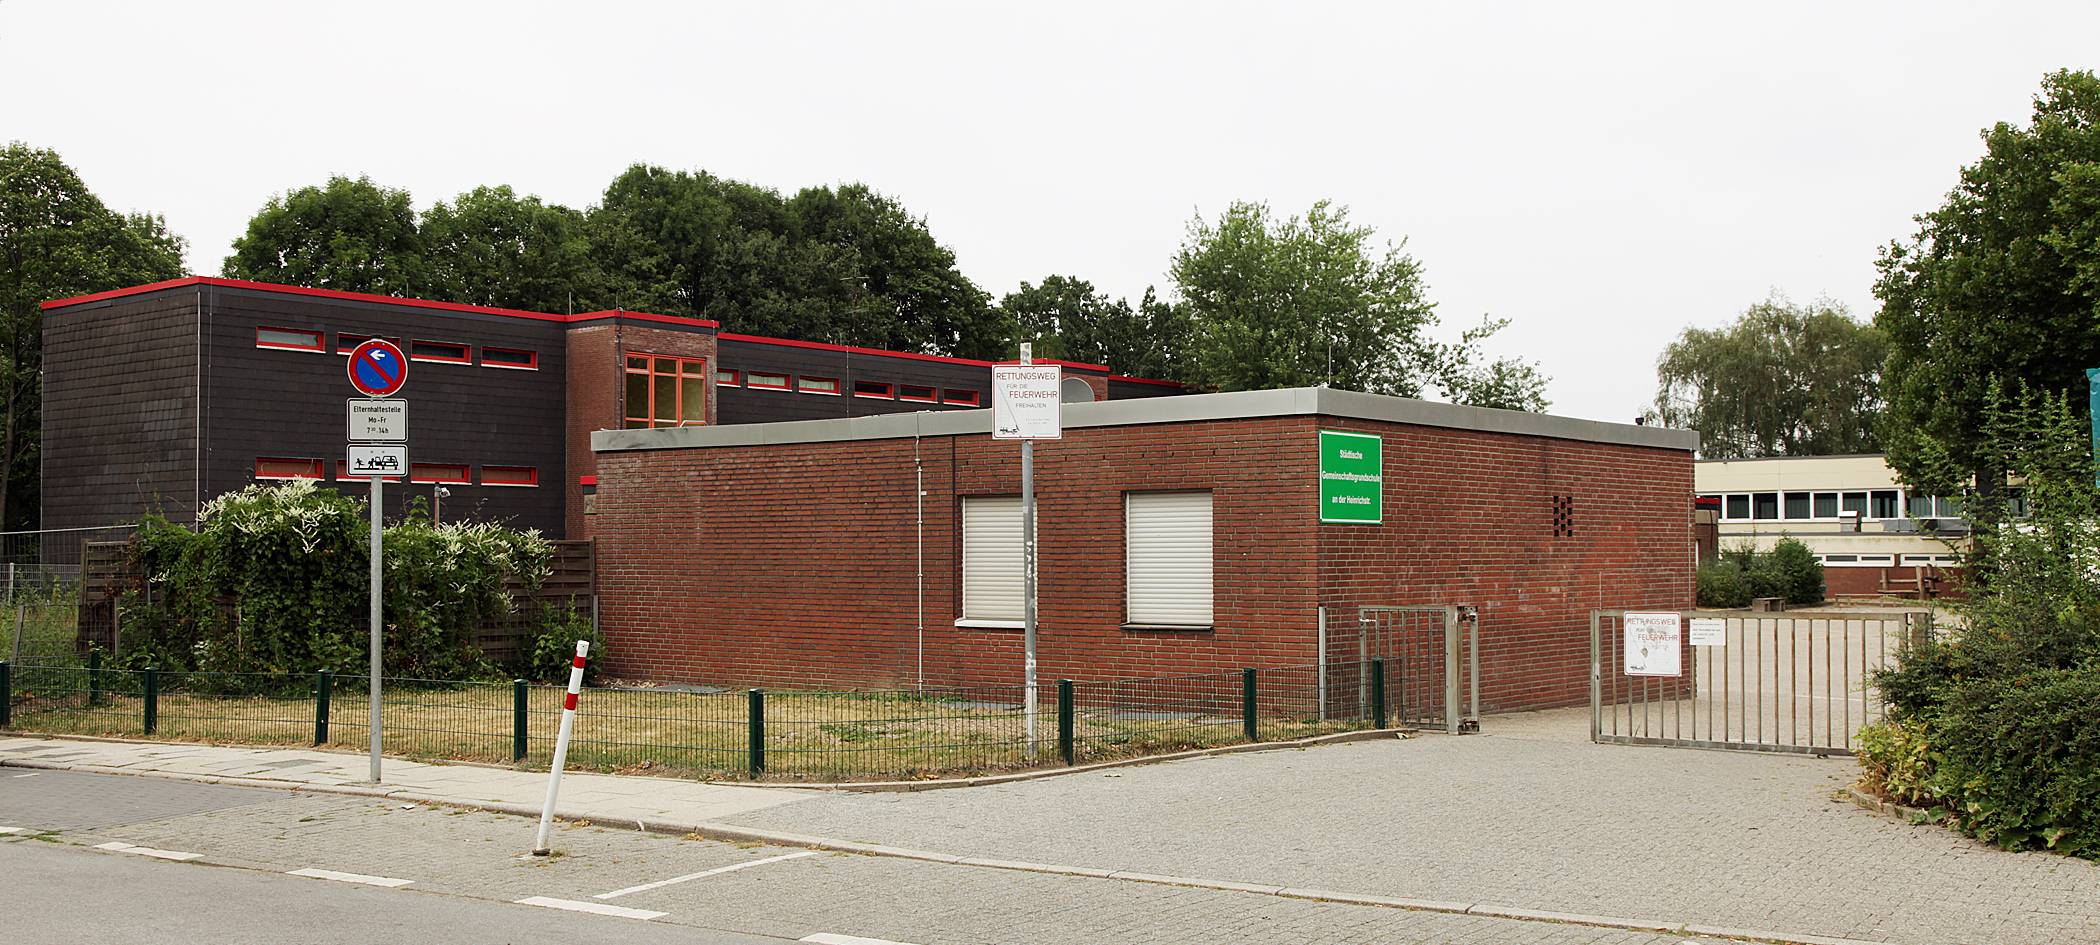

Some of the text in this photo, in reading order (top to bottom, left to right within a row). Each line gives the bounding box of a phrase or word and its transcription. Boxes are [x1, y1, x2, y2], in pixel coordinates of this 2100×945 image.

[996, 372, 1056, 381] RETTUNGSWEG
[1009, 390, 1058, 399] FEUERWEHR
[353, 405, 401, 413] Elternhaltestelle
[1339, 449, 1363, 460] Städtische
[1321, 470, 1380, 483] Gemeinschaftsgrundschule
[1331, 496, 1338, 504] an
[1338, 494, 1347, 504] der
[1637, 633, 1679, 641] FEUERWEHR
